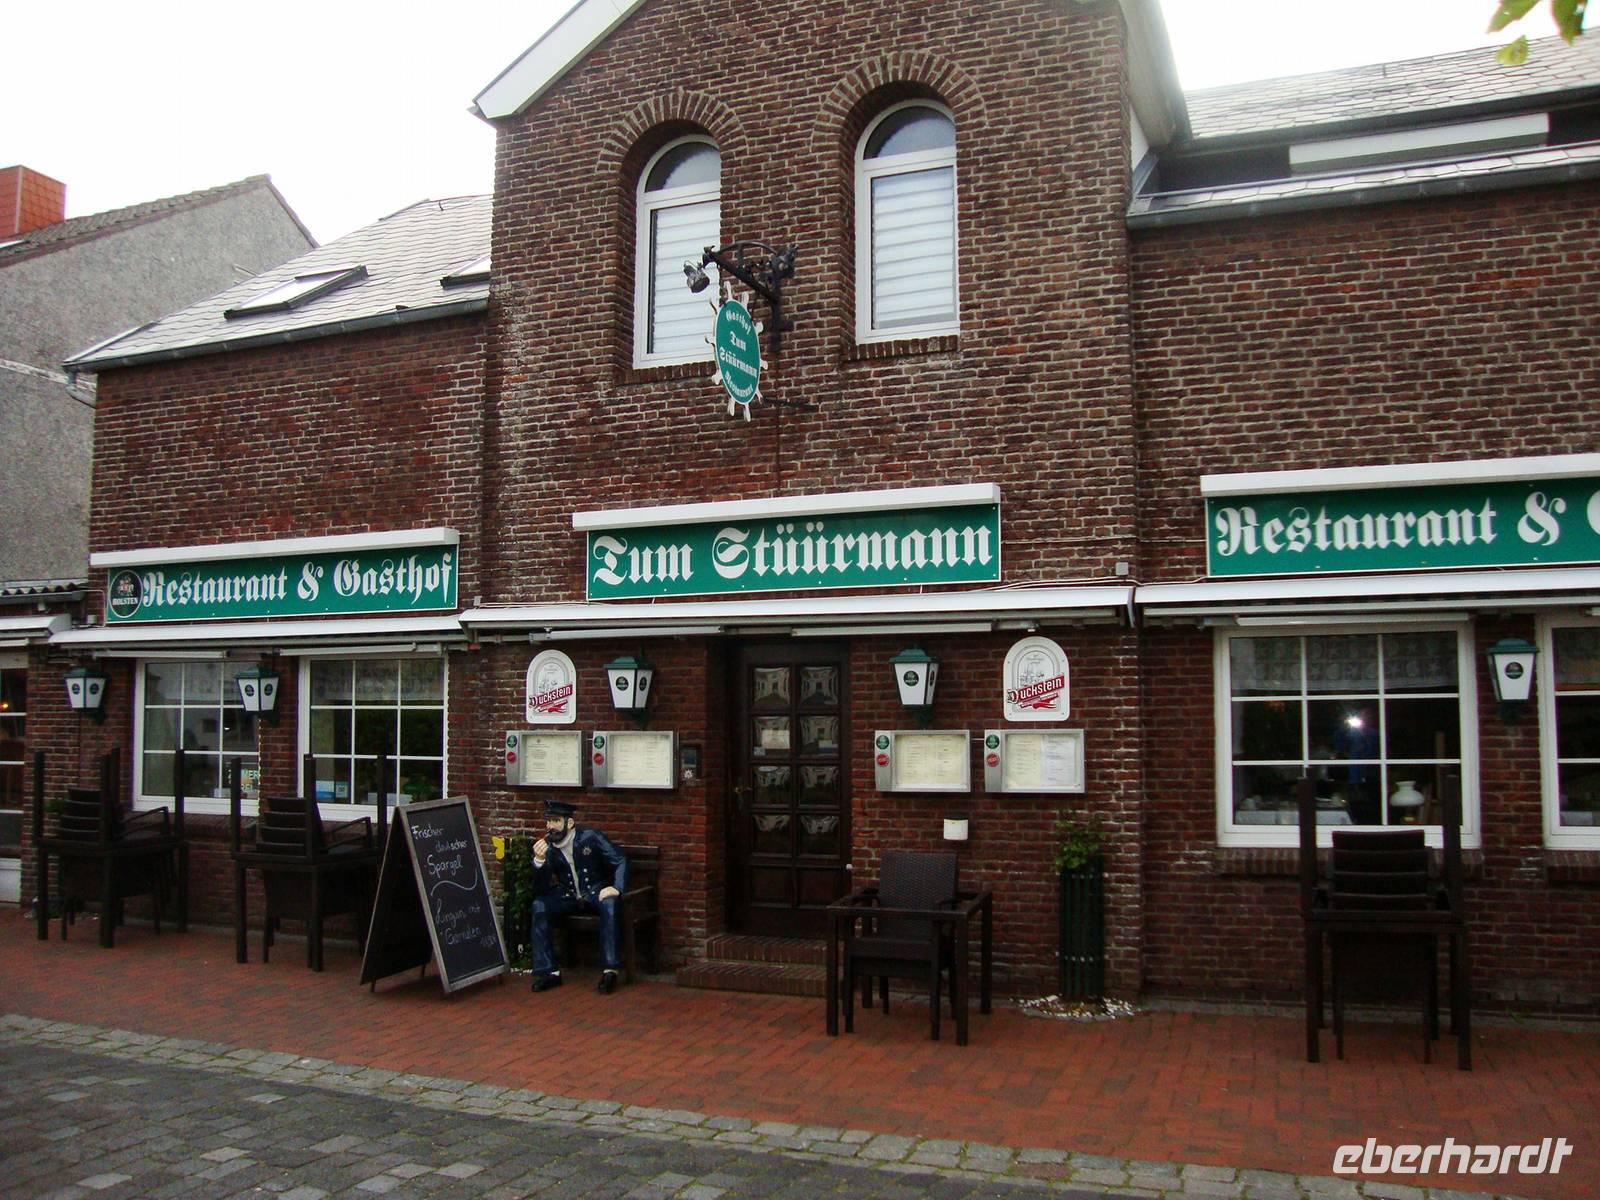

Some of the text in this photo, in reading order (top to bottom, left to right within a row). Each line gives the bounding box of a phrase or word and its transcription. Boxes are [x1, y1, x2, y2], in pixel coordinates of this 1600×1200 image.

[1215, 498, 1498, 556] Restaurant
[1517, 491, 1567, 546] &
[712, 521, 993, 579] Stüürmann
[142, 552, 452, 607] Restaurant & Gasthof
[112, 597, 139, 606] HOLSTEN
[529, 685, 572, 709] Duckstein
[1007, 677, 1063, 705] Duckstein
[426, 853, 464, 879] Spargel
